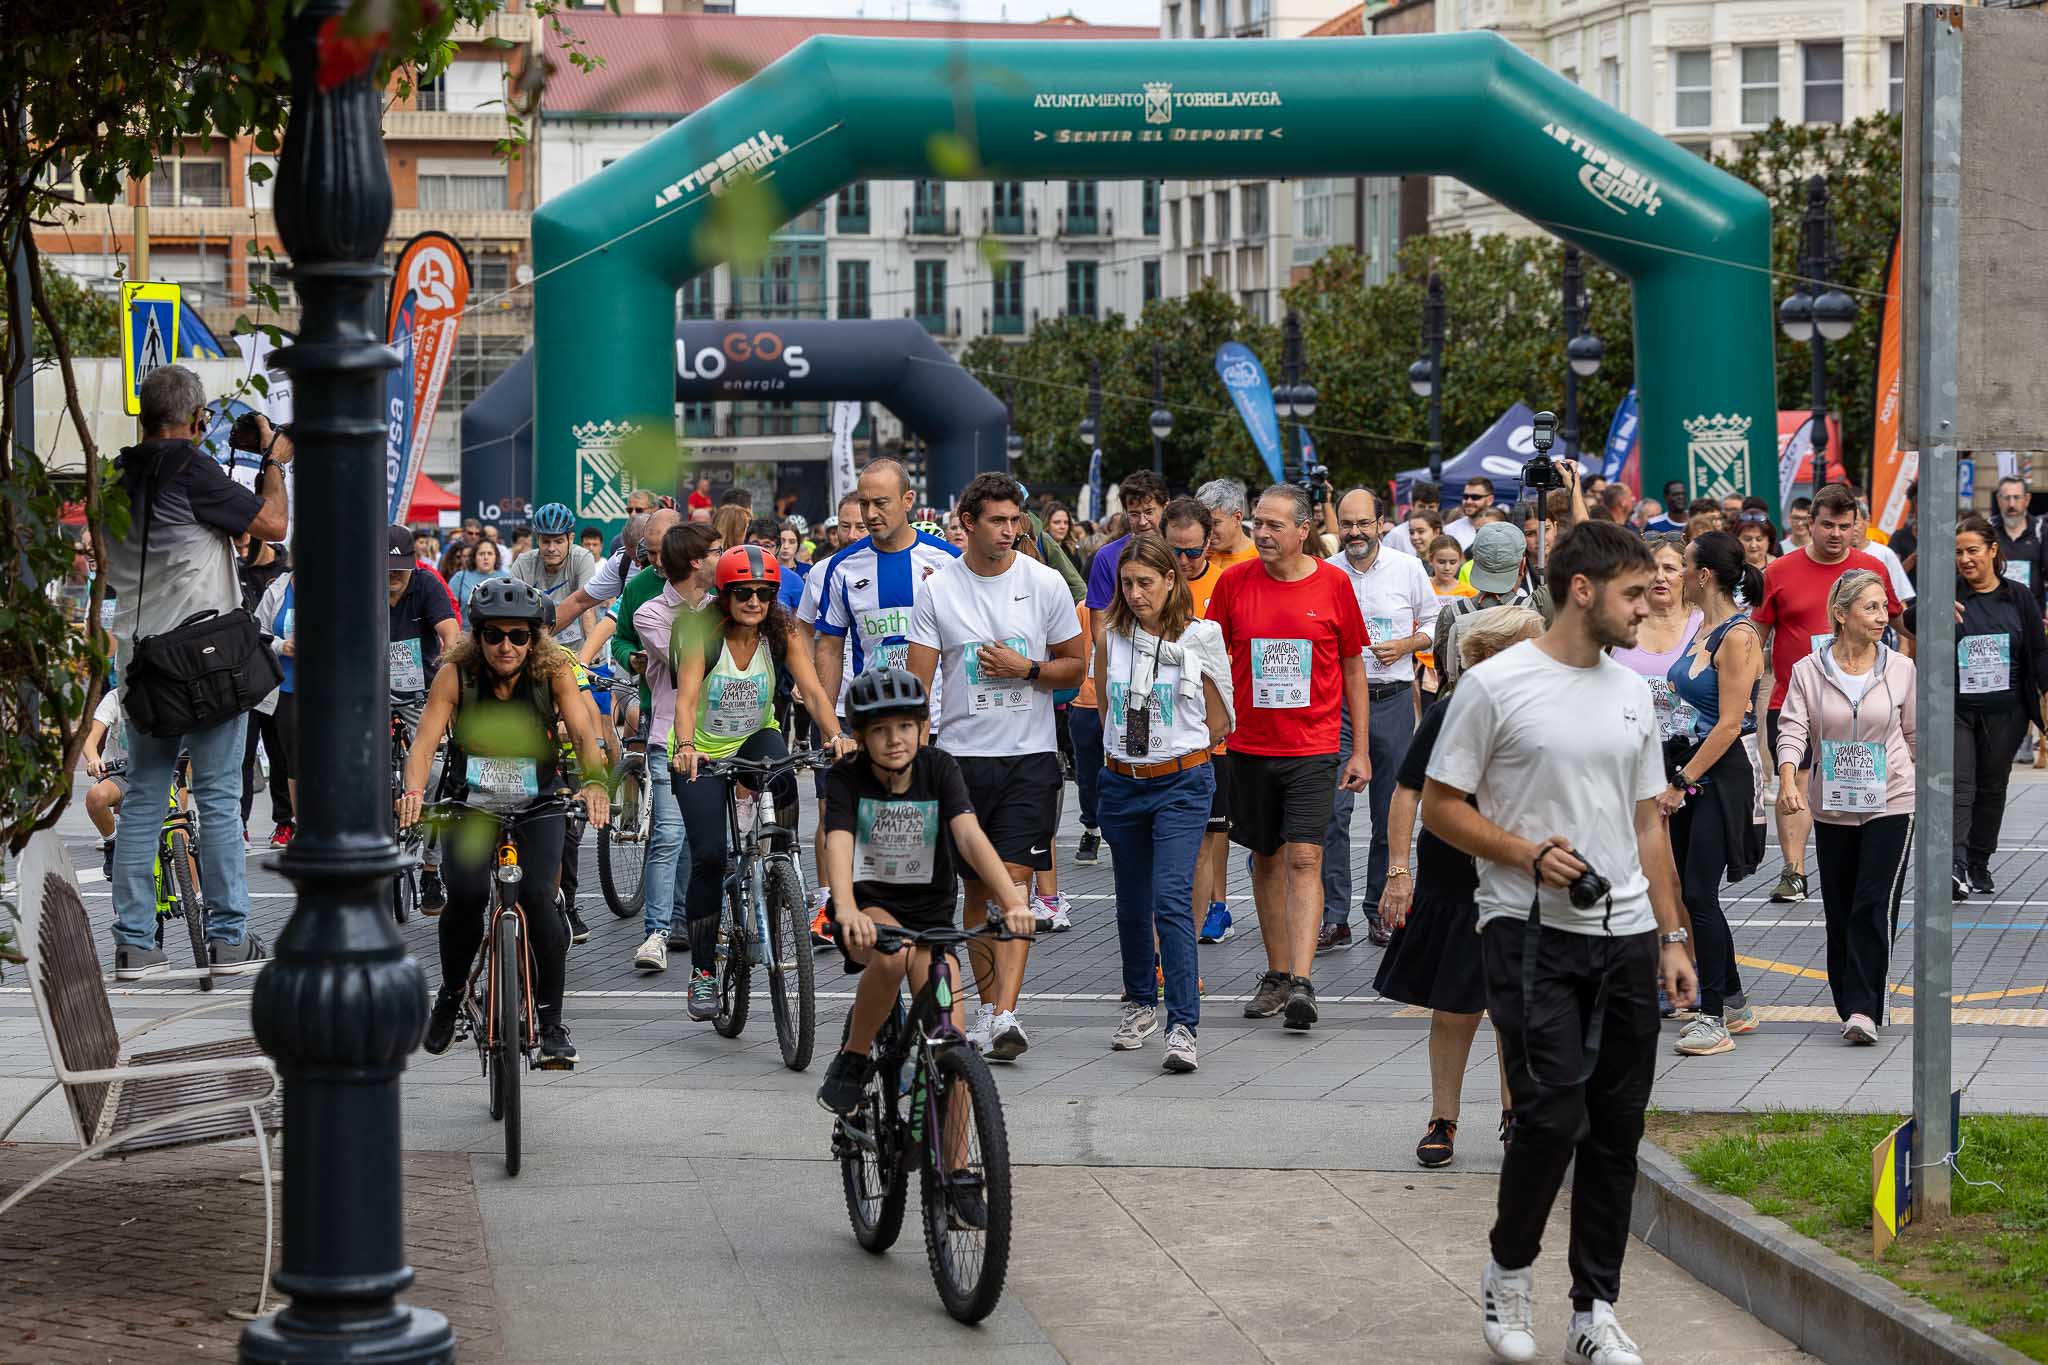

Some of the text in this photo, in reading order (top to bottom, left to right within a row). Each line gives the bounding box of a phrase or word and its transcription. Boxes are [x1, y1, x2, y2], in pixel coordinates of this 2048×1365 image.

[1034, 92, 1282, 108] AYUNTAMIENTO TORRELAVEGA
[1056, 129, 1133, 143] SENTIR
[1173, 128, 1265, 142] DEPORTE
[583, 473, 594, 496] AVE
[863, 610, 908, 636] bath
[1262, 653, 1286, 666] AMAT
[720, 690, 745, 701] AMAT
[1842, 744, 1872, 757] MARCHA
[1834, 755, 1859, 768] AMAT
[871, 818, 905, 833] AMAT
